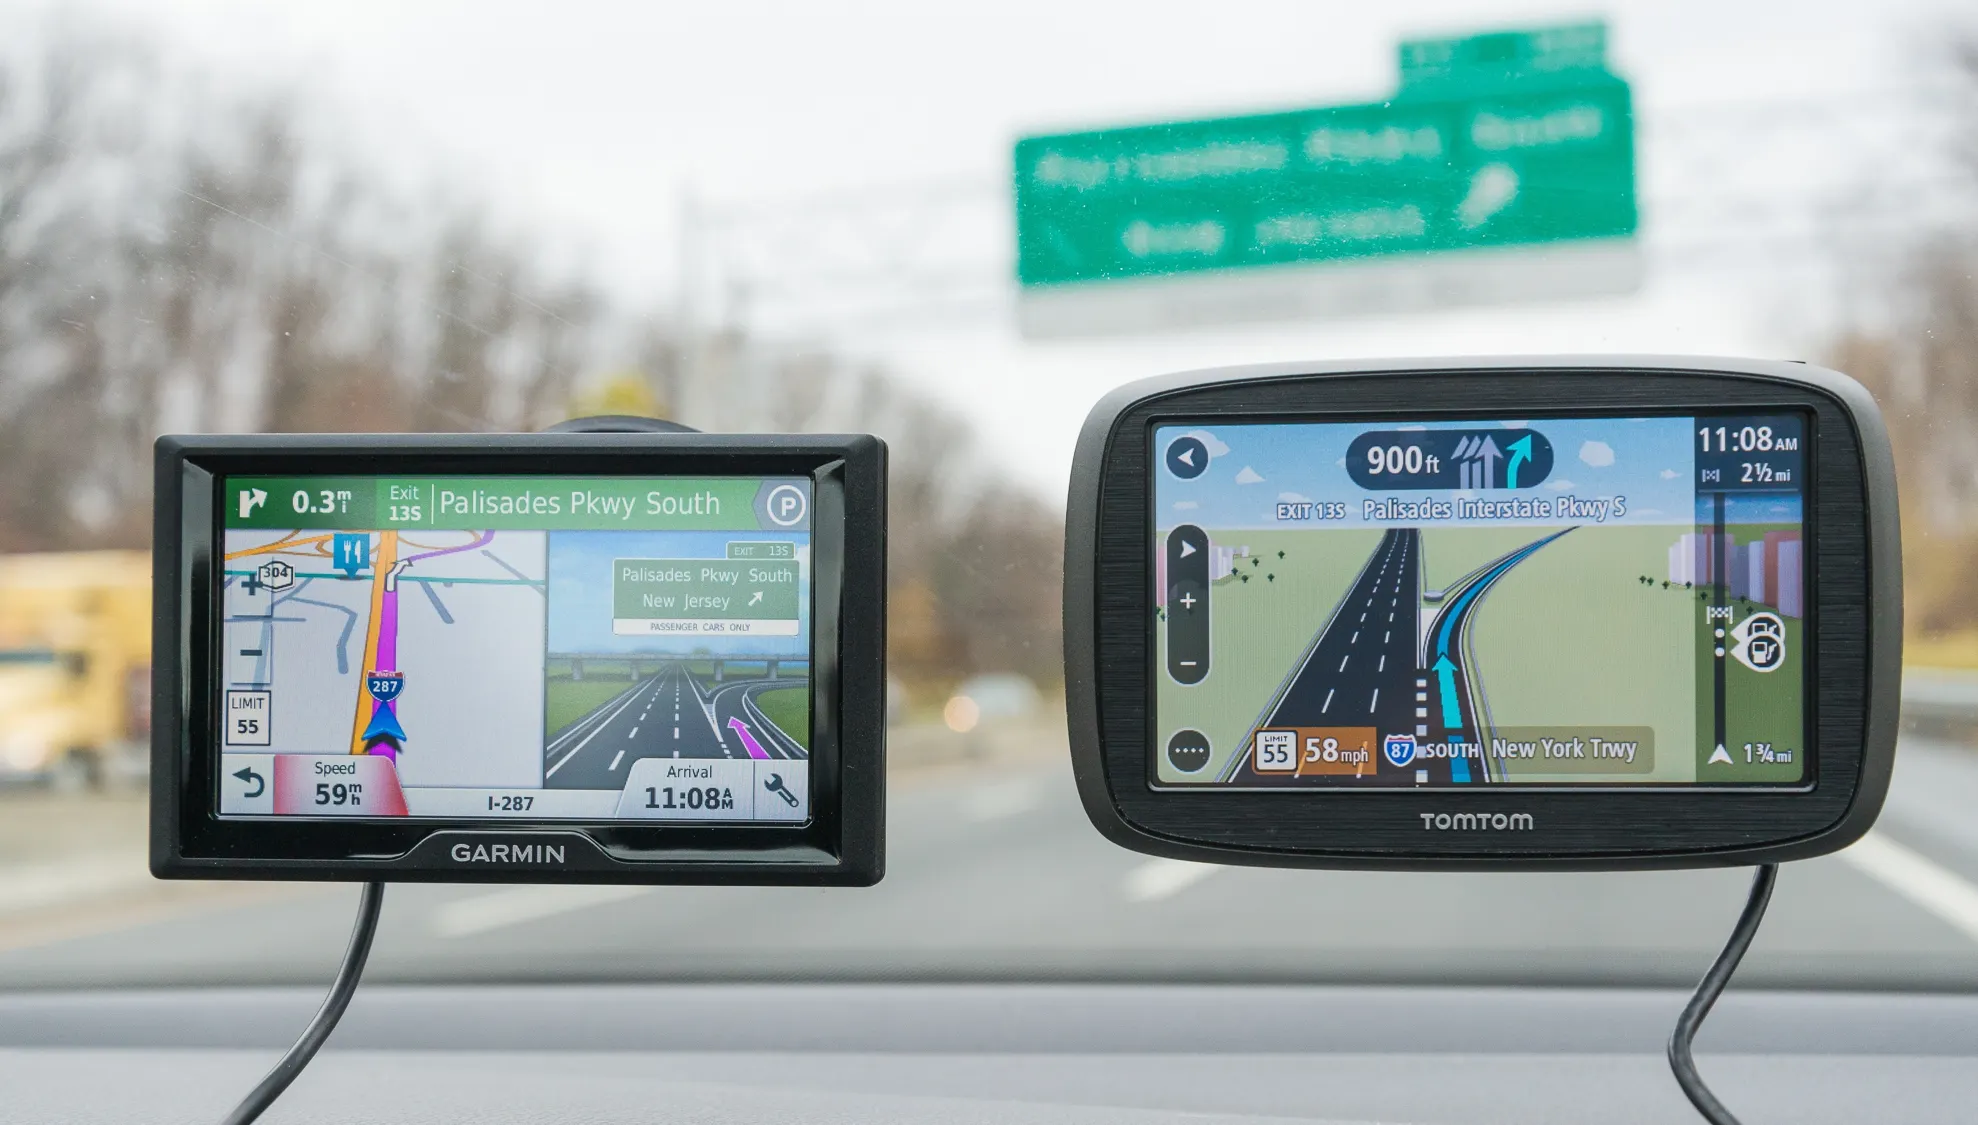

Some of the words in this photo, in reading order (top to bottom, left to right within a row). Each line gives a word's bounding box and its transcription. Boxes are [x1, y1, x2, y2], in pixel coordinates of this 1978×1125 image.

[1699, 426, 1773, 452] 11:08
[1775, 438, 1797, 451] AM
[1367, 446, 1423, 475] 900
[1425, 455, 1440, 473] ft
[1775, 469, 1790, 482] mi
[390, 486, 419, 500] Exit
[440, 490, 561, 515] Palisades
[571, 492, 636, 520] Pkwy
[646, 490, 720, 515] South
[781, 497, 796, 516] P
[1276, 503, 1312, 520] EXIT
[1315, 503, 1346, 519] 13S
[1363, 498, 1453, 520] Palisades
[1458, 498, 1550, 518] Interstate
[1557, 496, 1609, 522] Pkwy
[1613, 496, 1627, 517] S
[389, 506, 421, 521] 13S
[734, 546, 754, 556] EXIT
[769, 545, 789, 556] 13S
[263, 566, 288, 579] 304
[622, 567, 691, 583] Palisades
[701, 567, 739, 585] Pkwy
[749, 567, 792, 583] South
[643, 593, 675, 608] New
[683, 593, 730, 611] Jersey
[650, 622, 698, 632] PASSENGER
[702, 623, 725, 632] CARS
[729, 623, 750, 632] ONLY
[372, 680, 398, 693] 287
[231, 697, 265, 710] LIMIT
[237, 719, 258, 734] 55
[1264, 735, 1288, 743] LIMIT
[1263, 744, 1288, 764] 55
[1304, 738, 1339, 763] 58
[1340, 748, 1369, 766] mph
[1391, 743, 1410, 759] 87
[1425, 742, 1480, 759] SOUTH
[1492, 739, 1536, 759] New
[1540, 737, 1585, 759] York
[1589, 739, 1638, 764] Trwy
[1776, 750, 1792, 763] mi
[314, 762, 356, 776] Speed
[666, 765, 713, 780] Arrival
[314, 783, 348, 806] 59
[645, 787, 720, 810] 11:08
[488, 796, 534, 812] I-287
[1420, 812, 1534, 831] TOMTOM
[451, 843, 565, 864] GARMIN
